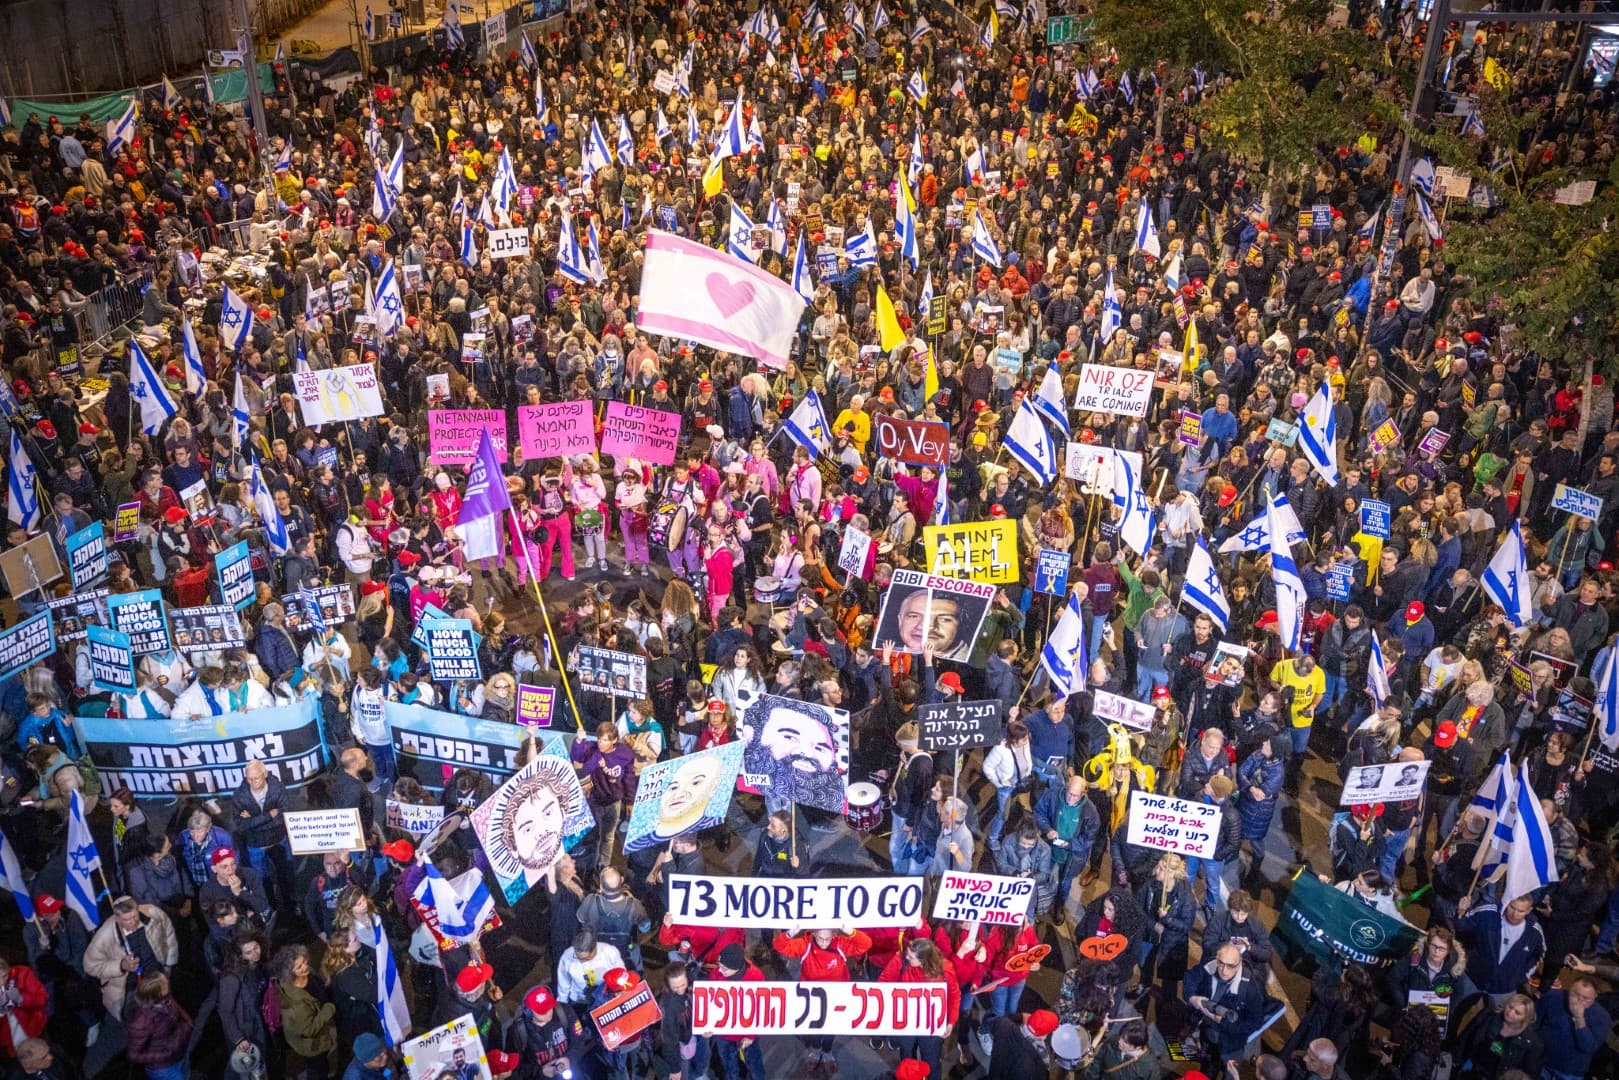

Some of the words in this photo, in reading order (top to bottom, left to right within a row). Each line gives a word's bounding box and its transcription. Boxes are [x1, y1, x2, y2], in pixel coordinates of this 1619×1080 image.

[1084, 368, 1114, 387] NIR
[1122, 372, 1148, 391] OZ
[1098, 386, 1133, 398] TRIALS
[1078, 396, 1097, 408] ARE
[547, 405, 583, 416] נפלתם
[436, 412, 498, 424] NETANYAHU
[537, 419, 577, 433] האמא
[649, 424, 677, 438] כאבי
[434, 428, 483, 440] PROTECTO
[491, 428, 505, 437] OF
[568, 434, 590, 446] הלא
[534, 438, 561, 452] נכונה
[879, 422, 905, 457] Oy
[907, 426, 945, 463] Vey
[893, 571, 923, 586] BIBI
[926, 576, 994, 598] ESCOBAR
[119, 601, 151, 615] HOW
[117, 611, 157, 624] MUCH
[118, 620, 162, 633] BLOOD
[131, 633, 148, 644] ILL
[150, 631, 165, 641] BE
[433, 630, 462, 638] HOW
[432, 638, 468, 648] MUCH
[432, 648, 471, 657] BLOOD
[432, 659, 458, 669] WILL
[461, 660, 475, 668] BE
[435, 668, 476, 678] SPILLED?
[925, 708, 949, 720] את
[956, 704, 995, 719] תציל
[924, 719, 979, 733] המדינה
[243, 733, 285, 760] לא
[394, 731, 491, 766] בהסכם.
[129, 742, 238, 768] עוצרות
[286, 752, 319, 780] עד
[649, 767, 669, 779] יאיר
[643, 779, 663, 790] חזר
[745, 775, 767, 785] איתן
[1138, 797, 1166, 809] שחר
[425, 809, 442, 818] You
[1144, 812, 1176, 823] בבית
[1178, 817, 1206, 829] אבא
[1143, 824, 1180, 837] ועלמא
[1185, 831, 1209, 842] רוני
[1142, 835, 1178, 848] רוצות
[1184, 843, 1203, 853] גם
[945, 877, 993, 892] פעימה
[998, 881, 1032, 895] כולנו
[672, 879, 717, 918] 73
[724, 883, 818, 920] MORE
[828, 885, 869, 919] TO
[877, 883, 922, 918] GO
[946, 907, 979, 920] חיה
[693, 986, 787, 1029] החטופים
[795, 982, 828, 1029] כל
[851, 982, 884, 1029] כל
[892, 986, 947, 1035] קודם
[454, 1021, 466, 1035] אין
[418, 1029, 452, 1049] תקומה
